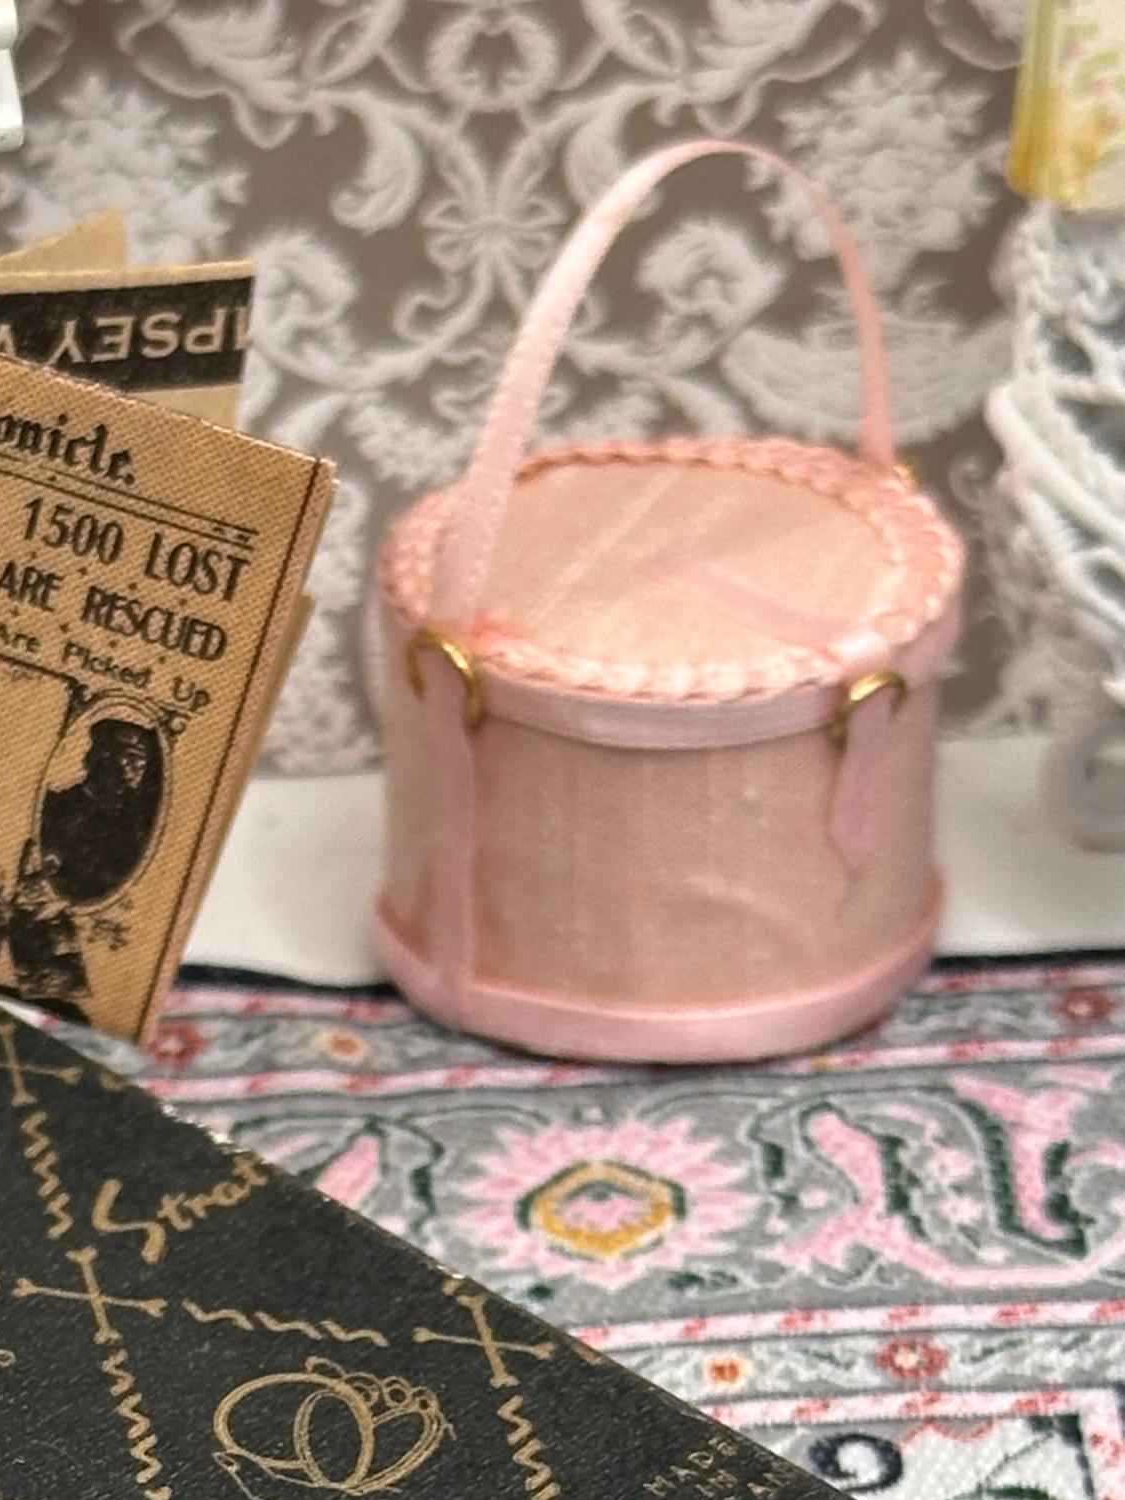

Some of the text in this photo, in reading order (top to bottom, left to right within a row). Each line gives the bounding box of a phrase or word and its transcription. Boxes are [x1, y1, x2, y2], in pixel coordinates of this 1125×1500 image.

[24, 497, 125, 566] 1500
[143, 532, 251, 602] LOST
[79, 585, 228, 662] RESCUED
[61, 640, 153, 689] Picked
